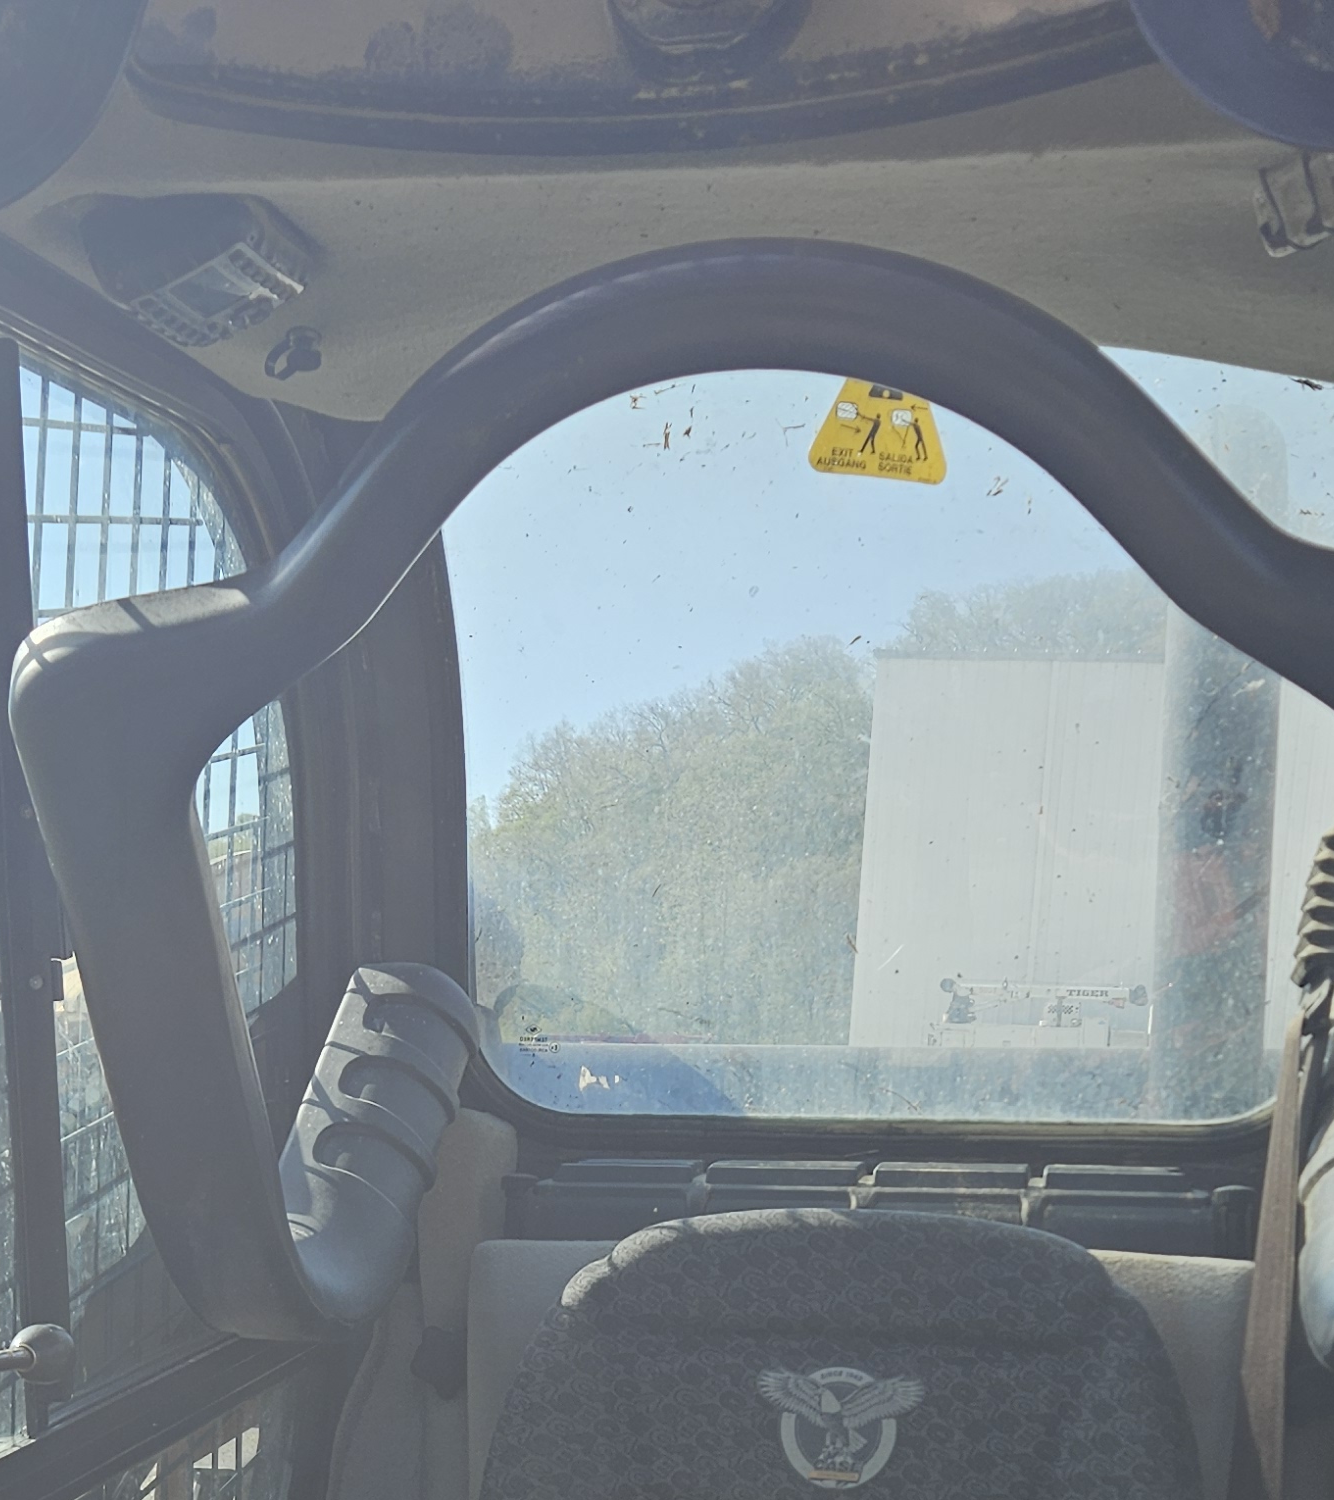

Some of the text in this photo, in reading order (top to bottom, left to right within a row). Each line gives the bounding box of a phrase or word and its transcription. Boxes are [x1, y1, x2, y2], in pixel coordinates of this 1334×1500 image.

[831, 447, 854, 458] EXIT
[878, 452, 913, 464] SALIDA
[877, 462, 912, 475] SORTIE
[1066, 989, 1109, 997] TIGER
